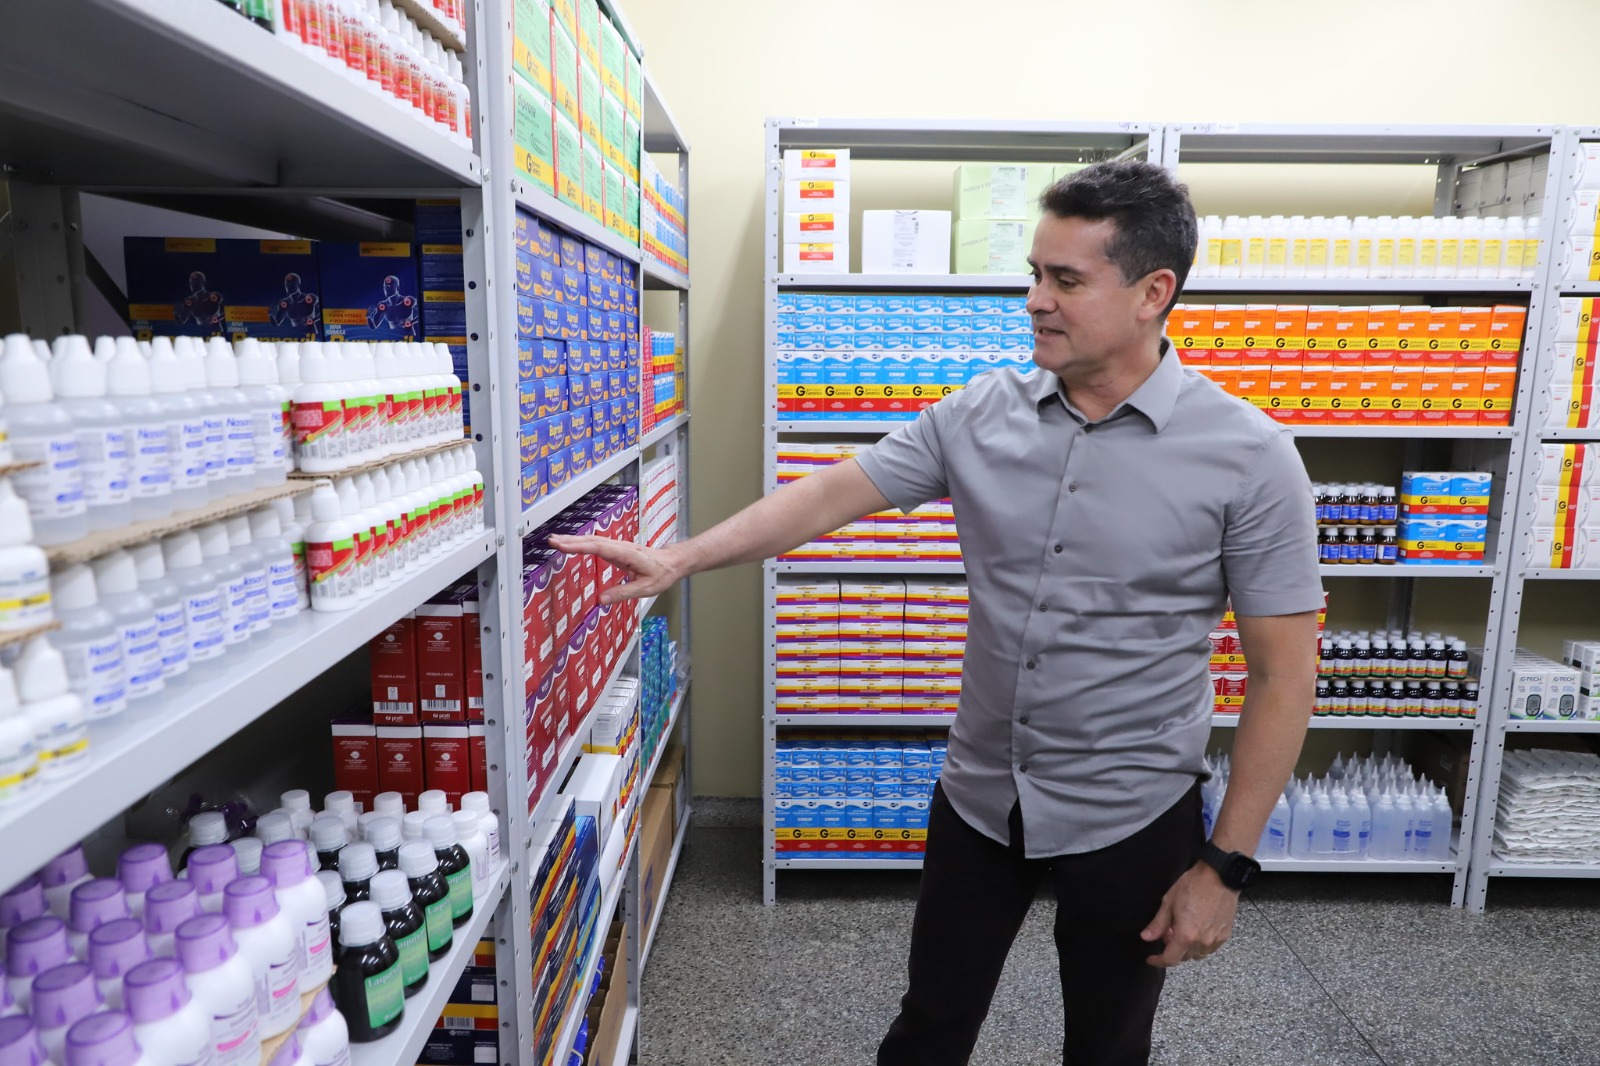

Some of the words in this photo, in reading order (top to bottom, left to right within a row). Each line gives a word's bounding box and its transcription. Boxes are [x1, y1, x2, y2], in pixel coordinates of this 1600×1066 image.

[526, 152, 531, 173] G
[1582, 314, 1589, 322] G
[1184, 337, 1193, 347] G
[1215, 338, 1224, 347] G
[1245, 337, 1254, 347] G
[1276, 338, 1285, 347] G
[1307, 339, 1316, 348] G
[1338, 339, 1347, 348] G
[1369, 338, 1378, 348] G
[1399, 339, 1408, 349] G
[1429, 339, 1438, 349] G
[1460, 340, 1469, 349] G
[1492, 339, 1500, 349] G
[1576, 358, 1583, 366] G
[796, 386, 805, 396] G
[826, 386, 834, 396] G
[855, 386, 864, 396] G
[884, 386, 893, 396] G
[913, 386, 922, 396] G
[1271, 397, 1280, 407] G
[1302, 398, 1310, 407] G
[1332, 398, 1341, 408] G
[1361, 398, 1370, 408] G
[1392, 398, 1401, 408] G
[1422, 399, 1432, 408] G
[1452, 399, 1461, 408] G
[1484, 399, 1493, 408] G
[1572, 401, 1579, 409] G
[1565, 459, 1572, 467] G
[1559, 501, 1566, 509] G
[793, 829, 801, 838] G
[820, 829, 829, 838] G
[847, 829, 856, 838] G
[874, 830, 883, 839] G
[902, 830, 910, 839] G
